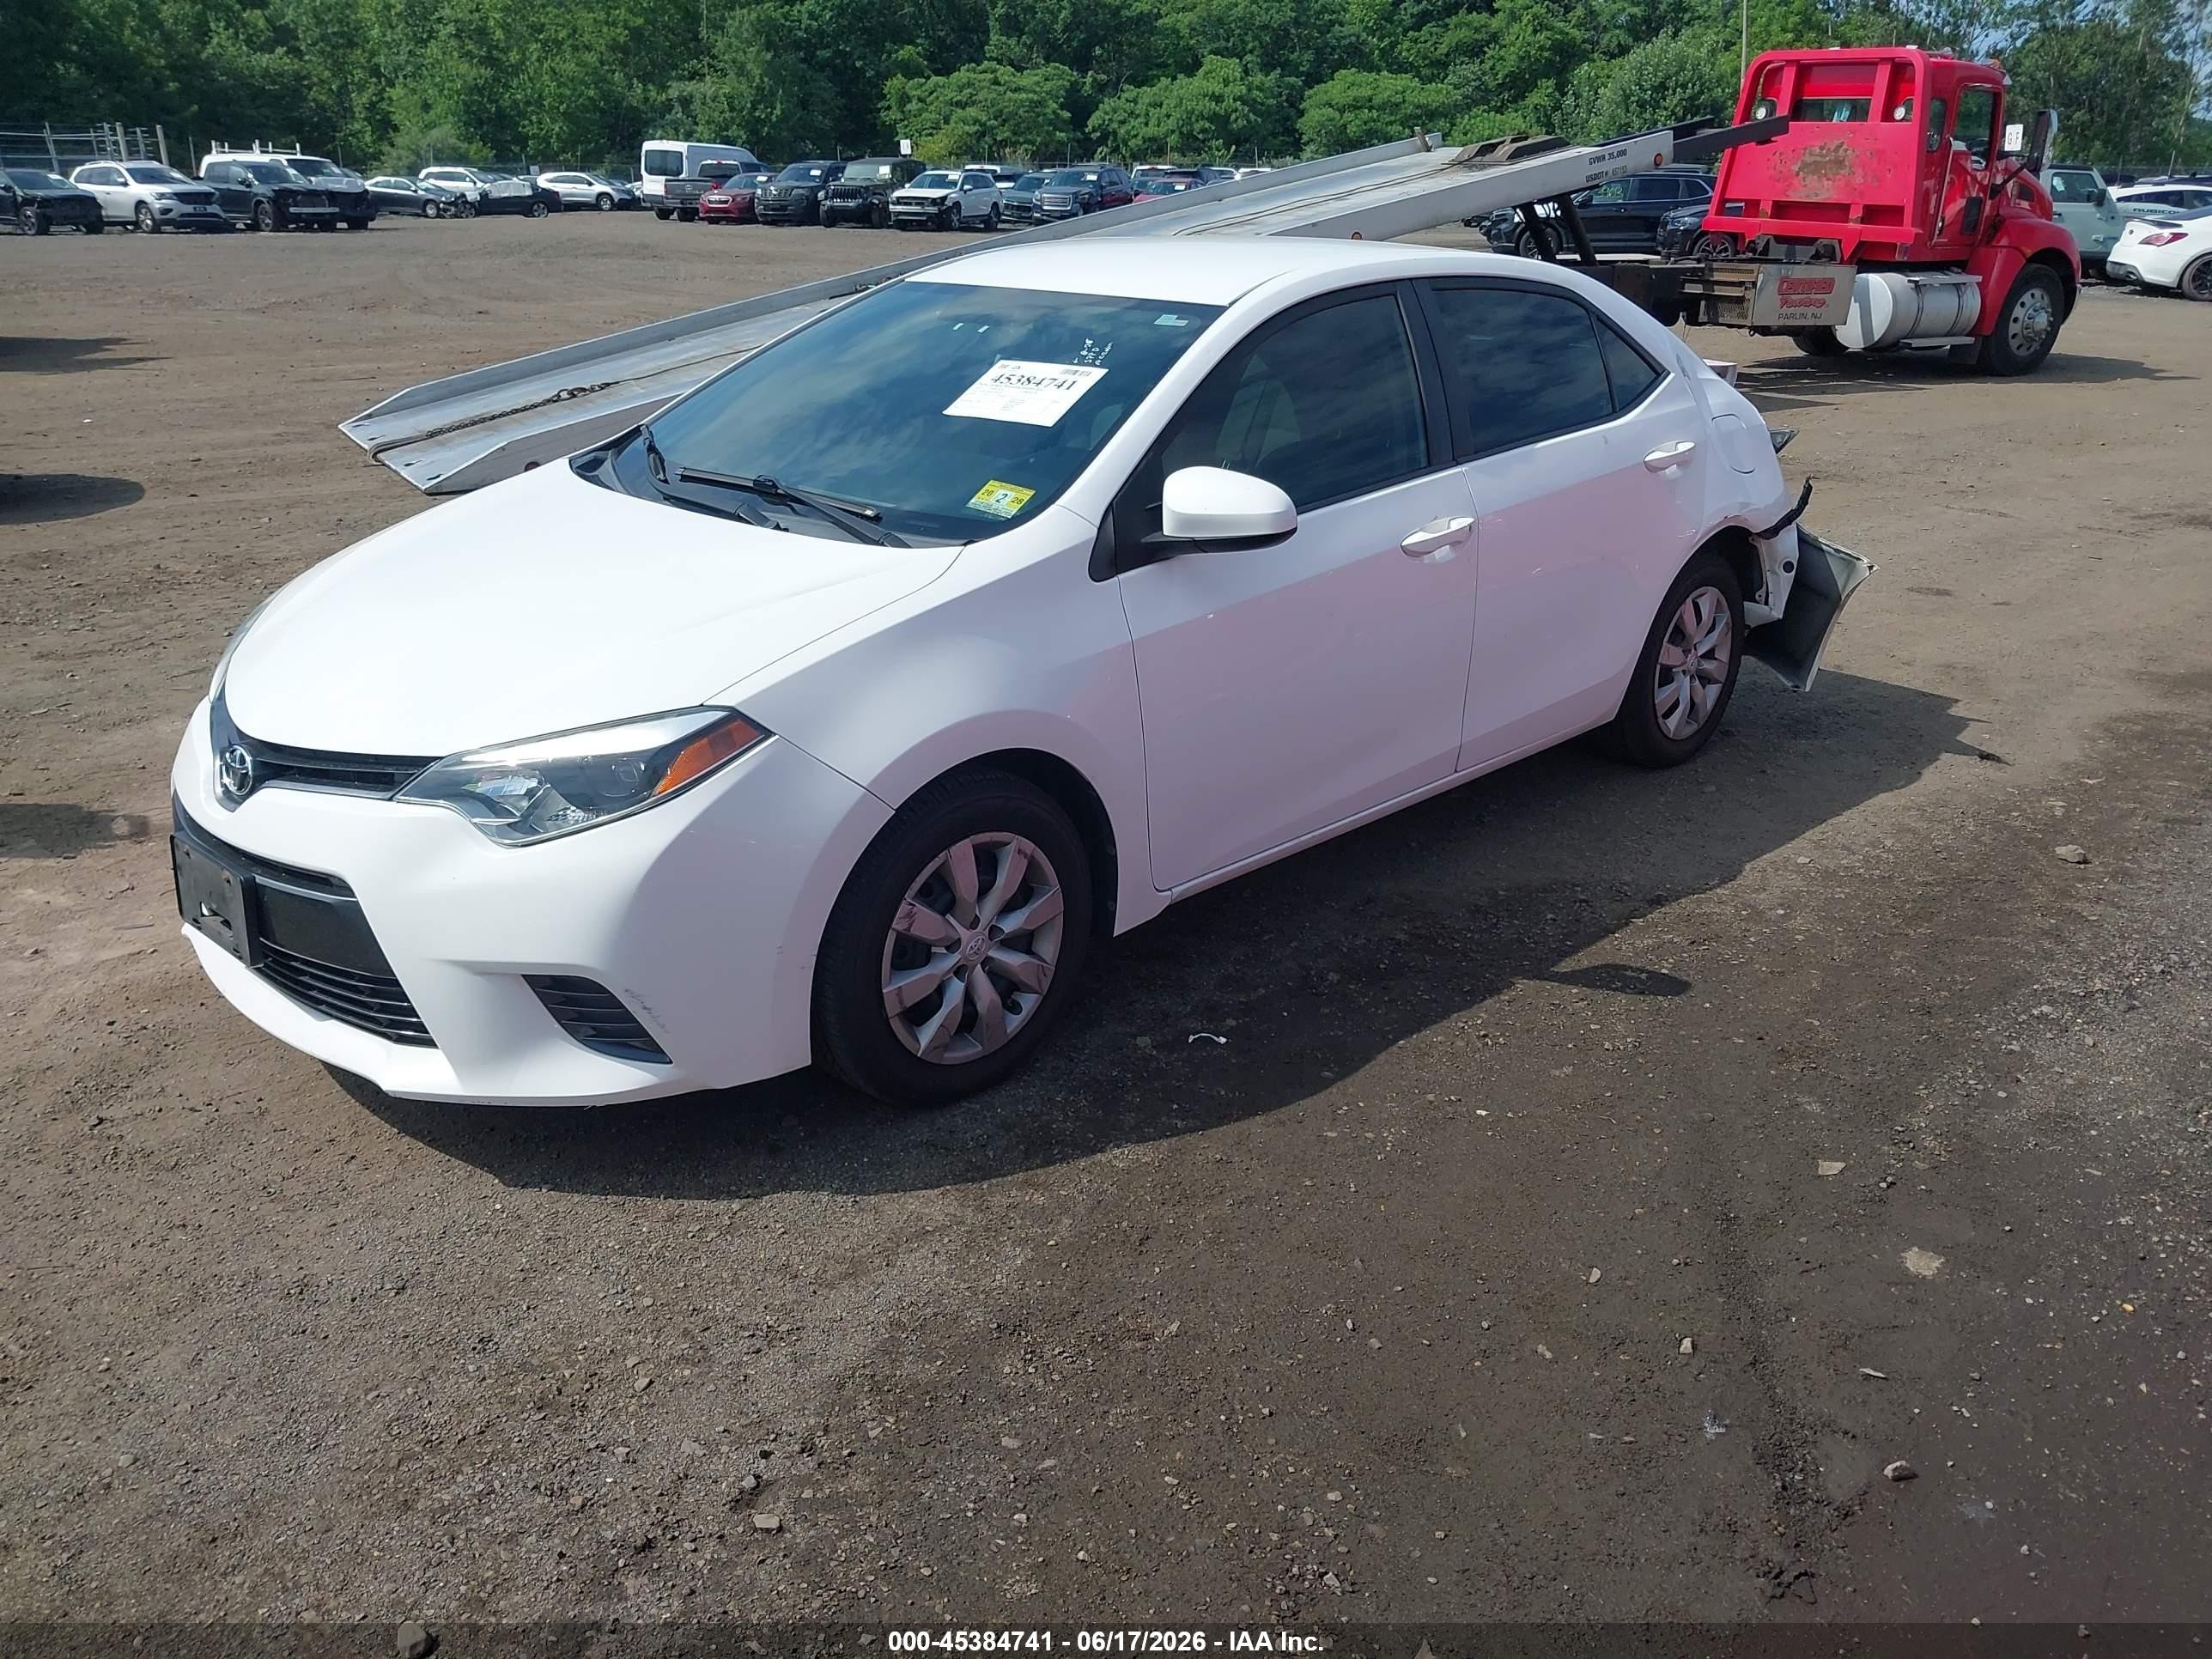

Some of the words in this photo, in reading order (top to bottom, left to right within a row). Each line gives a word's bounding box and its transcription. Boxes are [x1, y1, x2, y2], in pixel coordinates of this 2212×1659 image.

[1589, 153, 1606, 166] GVWR
[1607, 149, 1628, 161] 35,000
[991, 374, 1079, 391] 45384741
[981, 489, 994, 497] 20
[995, 493, 1009, 503] 2
[1011, 496, 1024, 505] 28
